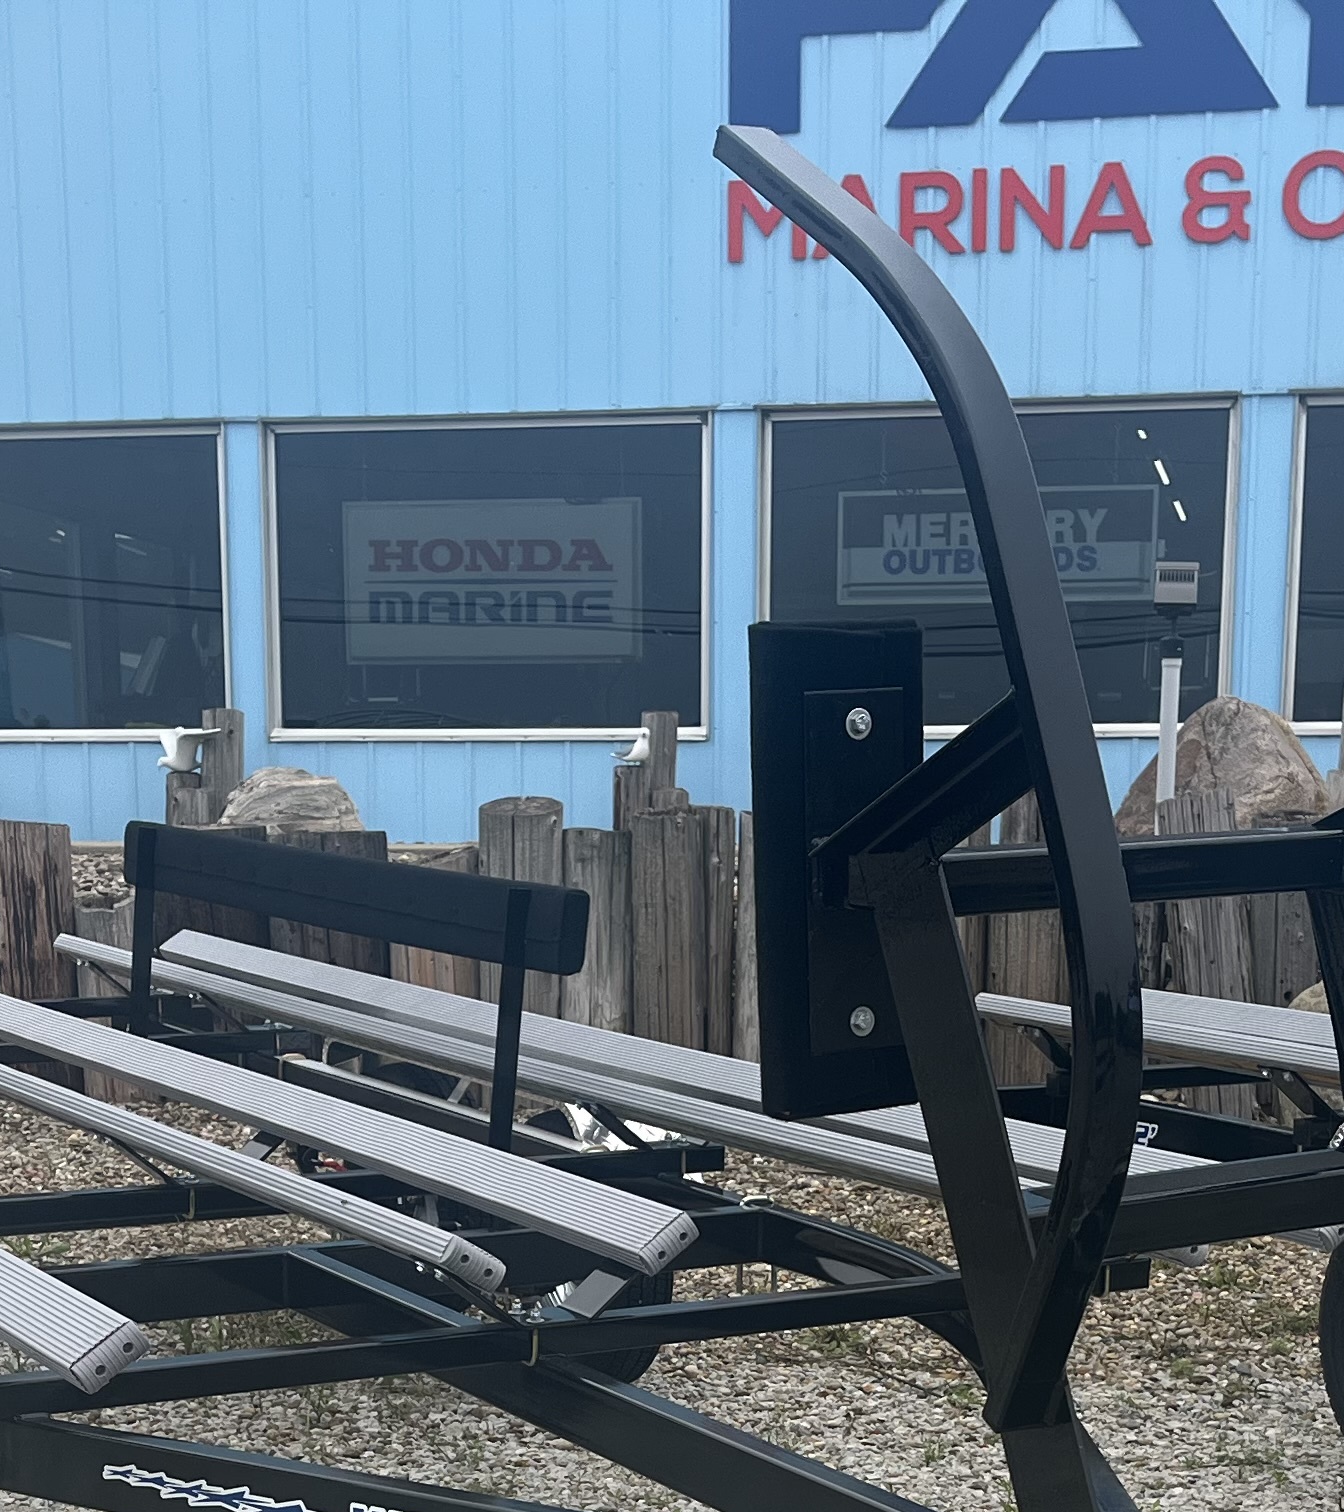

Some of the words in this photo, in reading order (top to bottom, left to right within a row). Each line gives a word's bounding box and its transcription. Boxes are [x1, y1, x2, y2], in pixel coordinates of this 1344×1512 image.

[1181, 155, 1252, 244] &
[882, 507, 1109, 549] MERRY
[367, 538, 614, 574] HONDA
[882, 545, 1098, 576] OUTBDS
